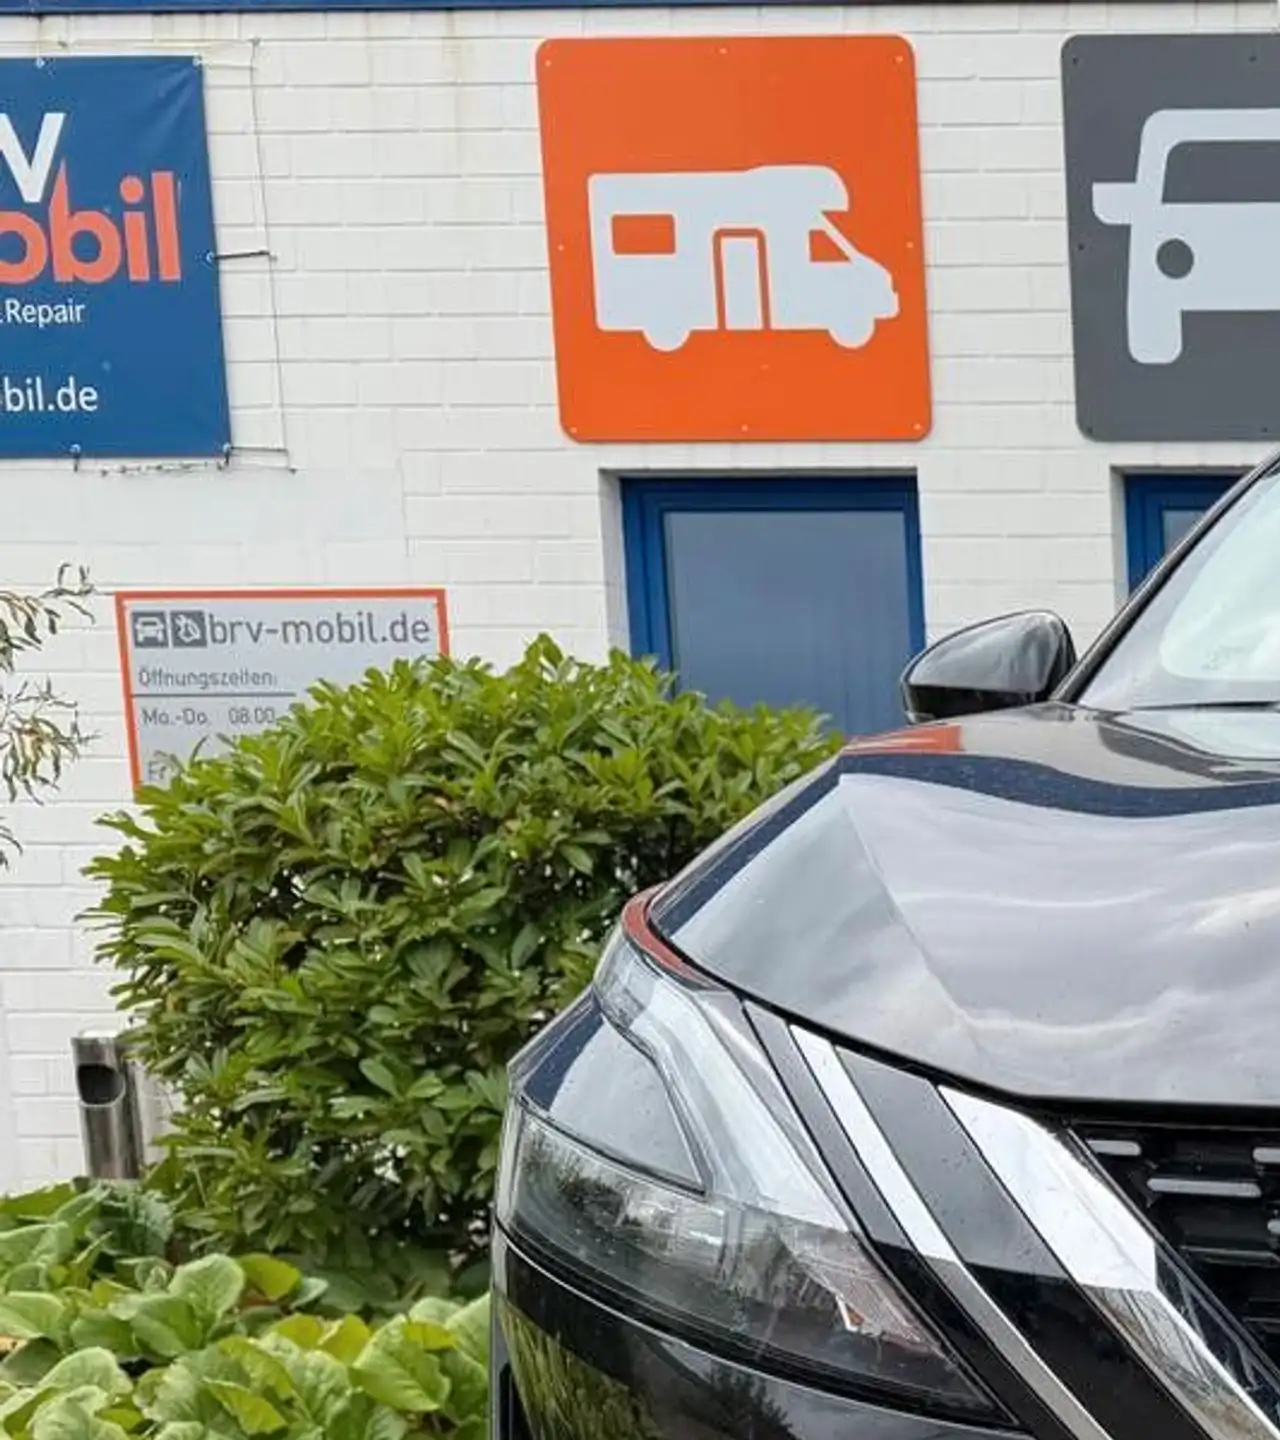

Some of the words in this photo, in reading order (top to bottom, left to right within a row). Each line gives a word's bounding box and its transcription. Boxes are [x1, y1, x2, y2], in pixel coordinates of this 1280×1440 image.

[5, 297, 86, 329] Repair
[0, 375, 98, 412] bil.de
[208, 610, 431, 645] brv-mobil.de
